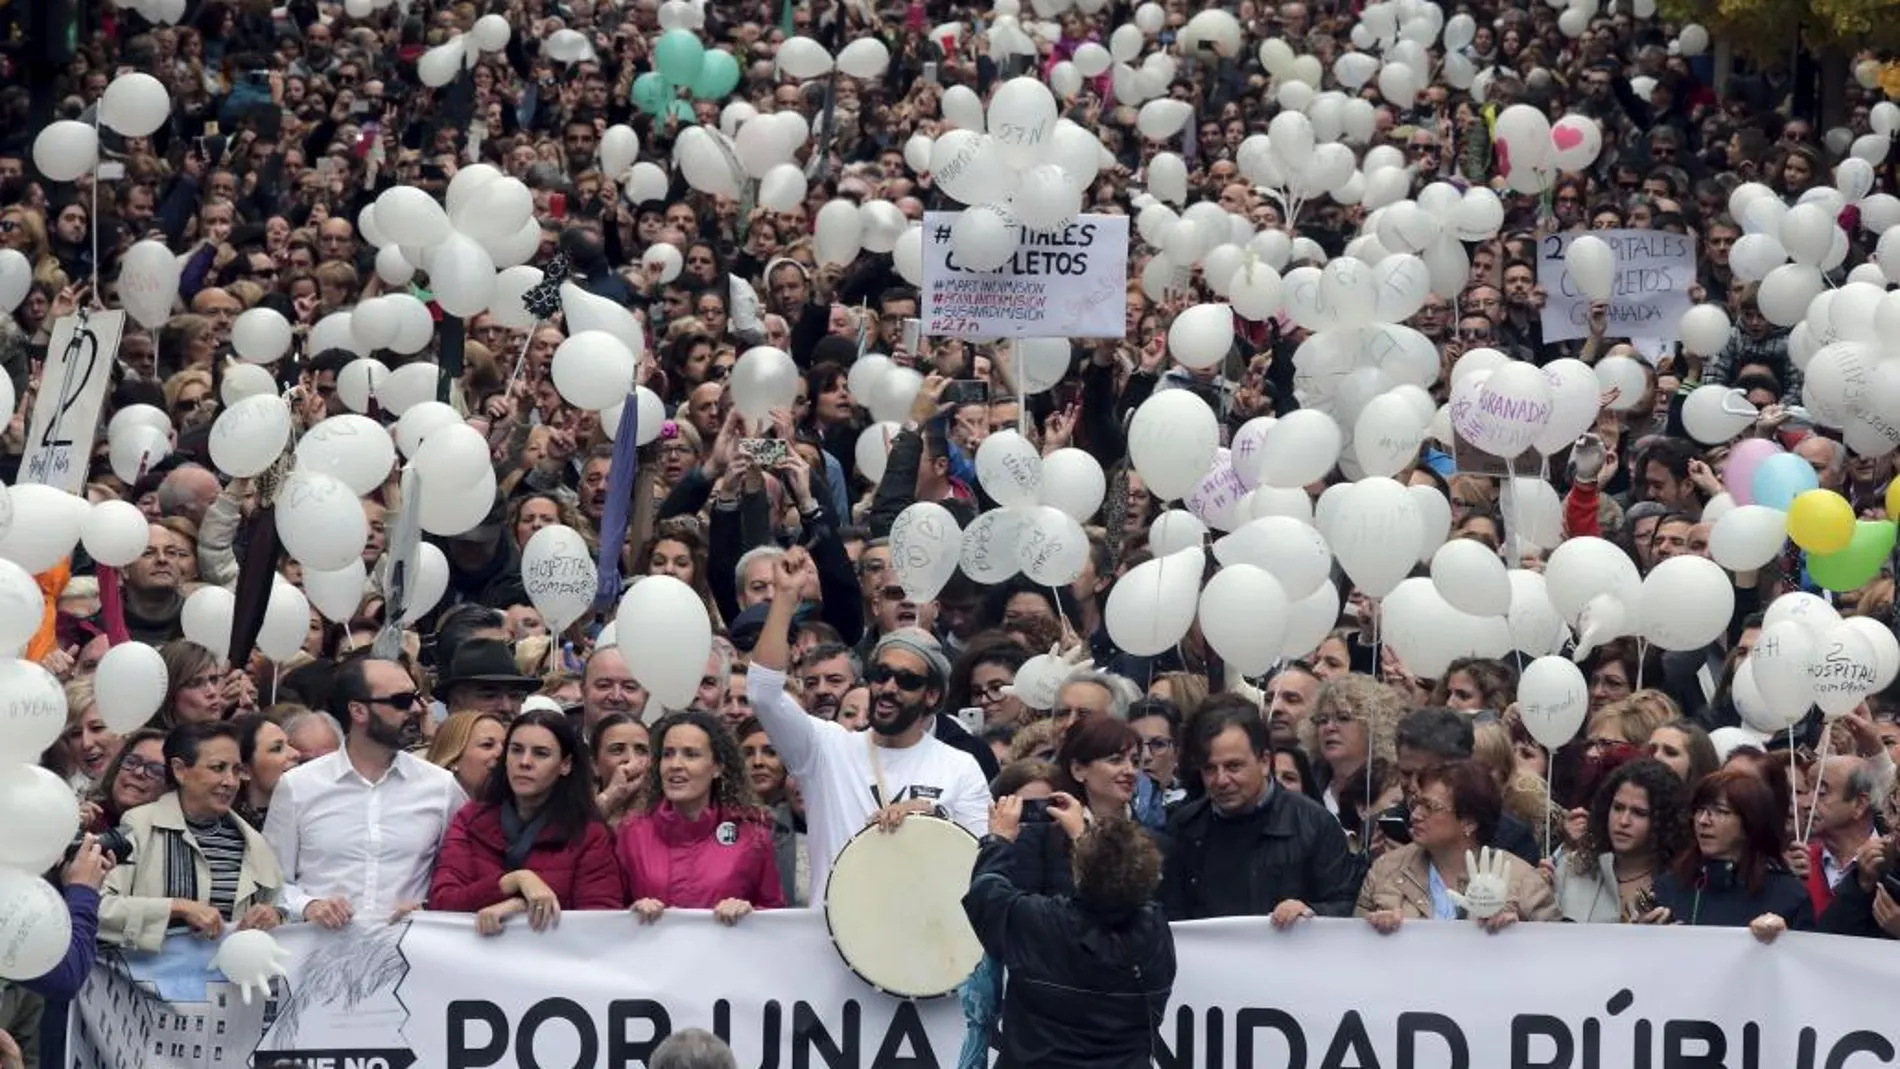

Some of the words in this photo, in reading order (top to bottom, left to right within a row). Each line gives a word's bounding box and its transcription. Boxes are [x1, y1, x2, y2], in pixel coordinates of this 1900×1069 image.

[1544, 236, 1565, 260] 2
[1825, 642, 1850, 662] 2
[446, 997, 673, 1069] POR
[713, 998, 944, 1069] UNA
